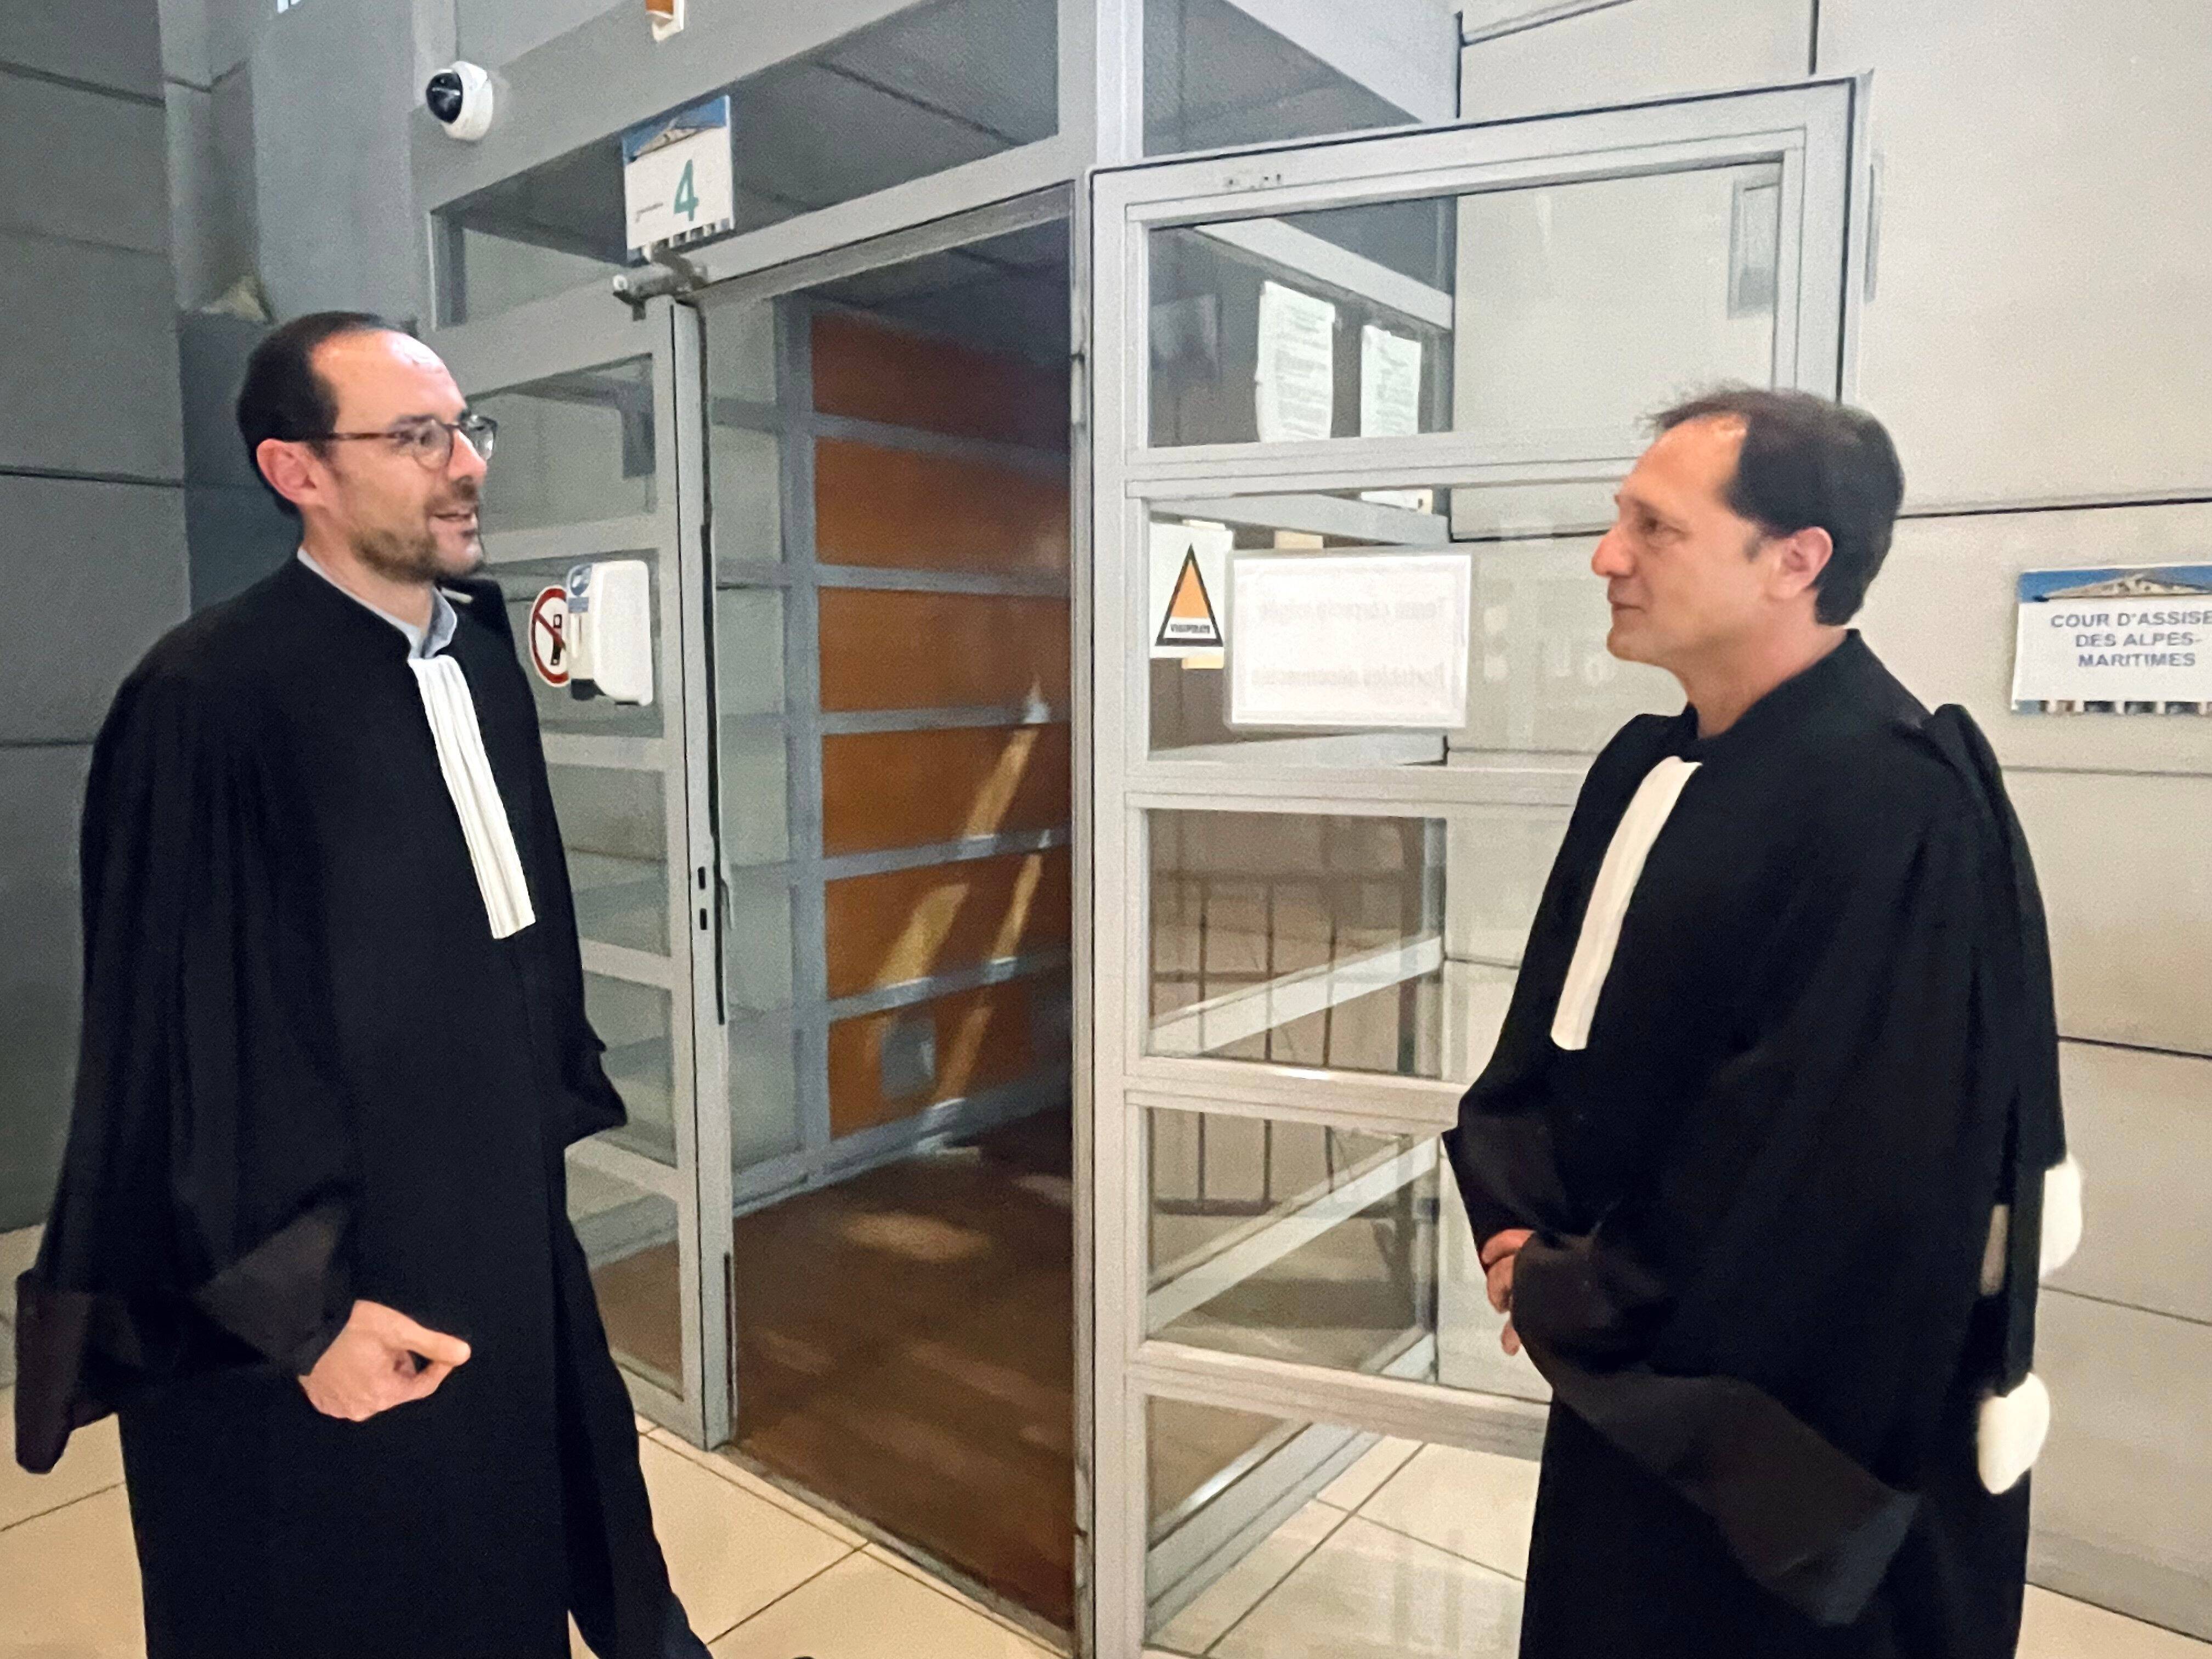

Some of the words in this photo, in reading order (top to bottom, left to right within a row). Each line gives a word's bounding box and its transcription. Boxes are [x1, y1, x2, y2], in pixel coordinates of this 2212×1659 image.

[674, 159, 699, 222] 4
[2051, 613, 2110, 628] COUR
[2075, 634, 2117, 647] DES
[2124, 632, 2202, 646] ALPES-
[2078, 653, 2196, 668] MARITIMES
